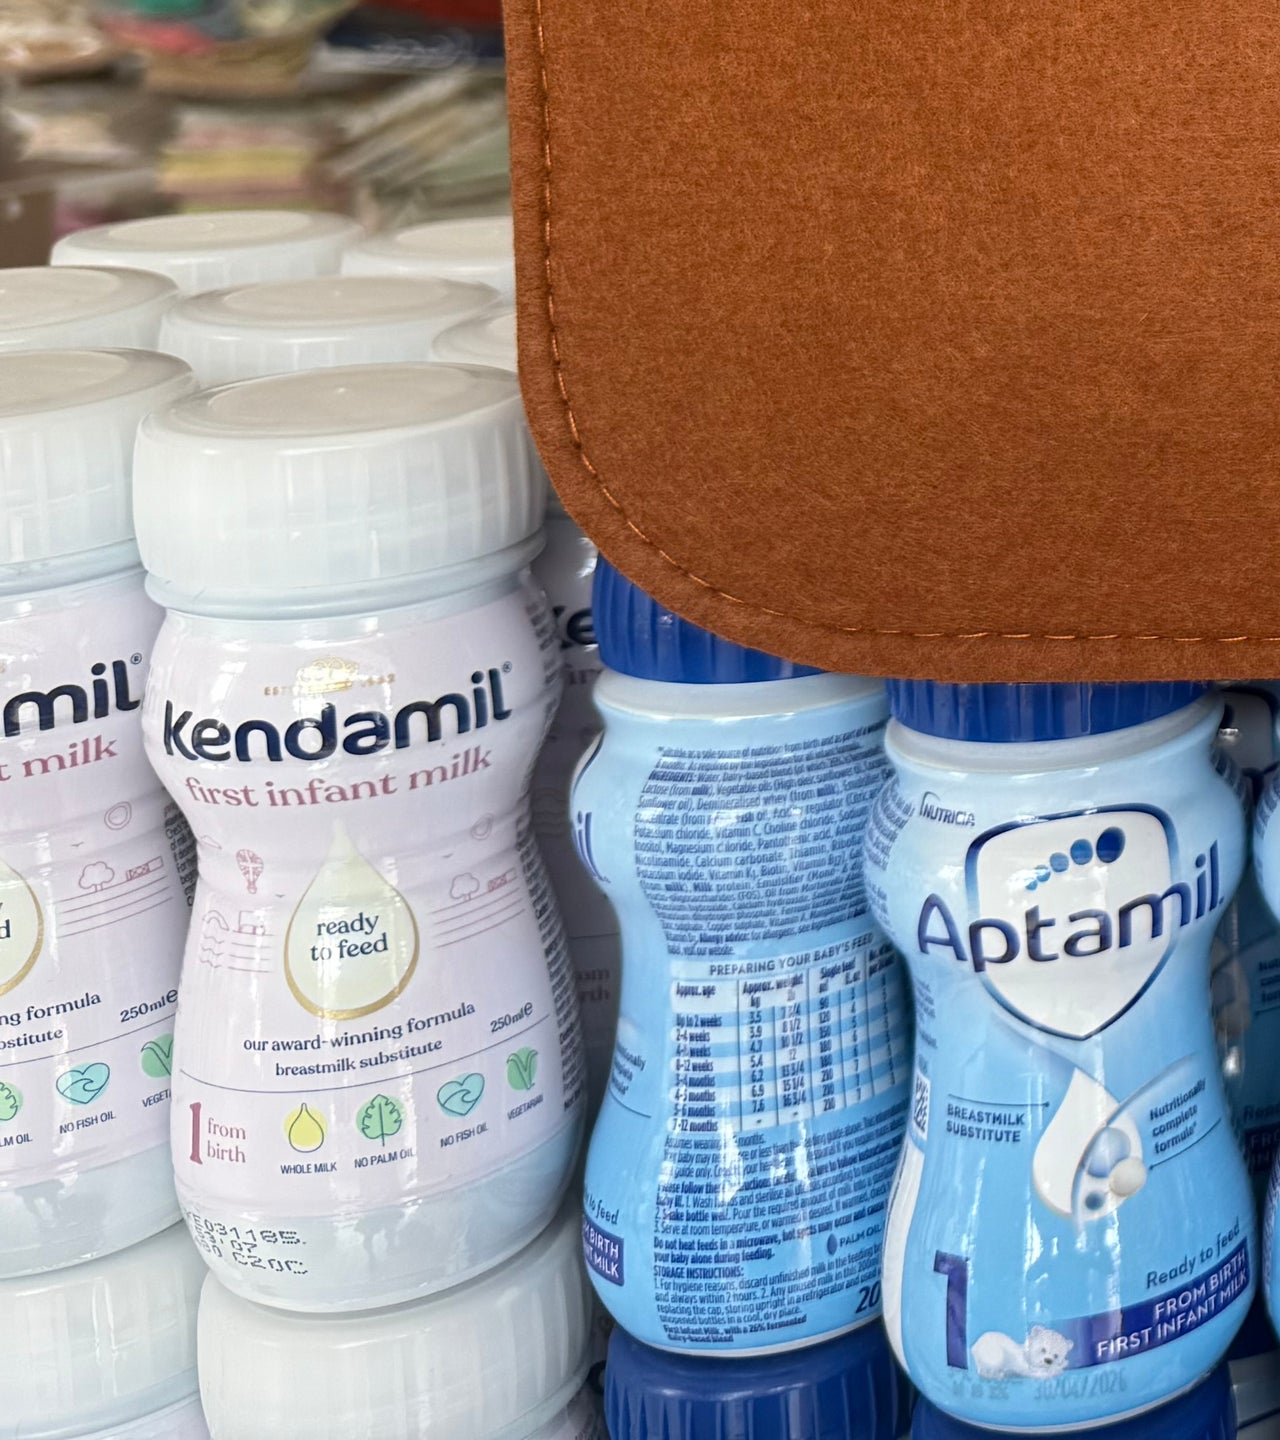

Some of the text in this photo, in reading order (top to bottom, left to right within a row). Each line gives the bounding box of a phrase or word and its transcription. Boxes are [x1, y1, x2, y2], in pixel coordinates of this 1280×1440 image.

[22, 734, 118, 778] milk
[185, 745, 493, 808] first infant milk
[922, 801, 976, 828] NUTRICIA
[917, 840, 1220, 973] Aptamil
[316, 912, 380, 938] ready
[310, 932, 389, 962] to feed
[709, 958, 776, 977] PREPARING
[778, 953, 811, 969] YOUR
[813, 940, 851, 961] BABY'S
[26, 991, 102, 1023] formula
[243, 1001, 476, 1054] our award-winning formula
[274, 1038, 444, 1078] breastmilk substitute
[946, 1103, 1025, 1127] BREASTMILK
[1148, 1078, 1207, 1122] Nutritionally
[59, 1110, 117, 1135] NO FISH OIL
[189, 1101, 247, 1165] 1 from
[440, 1123, 489, 1149] NO FISH OIL
[946, 1121, 1022, 1144] SUBSTITUTE
[1151, 1103, 1199, 1139] complete
[15, 1133, 34, 1145] OIL
[206, 1142, 247, 1164] birth
[280, 1161, 338, 1176] WHOLE MILK
[354, 1147, 416, 1169] NO PALM OIL
[840, 1231, 865, 1248] PALM
[1146, 1215, 1242, 1290] Ready to feed
[653, 1264, 745, 1279] STORAGE INSTRUCTIONS:
[1155, 1248, 1247, 1322] FROM BIRTH
[933, 1249, 968, 1370] 1
[1096, 1268, 1249, 1360] FIRST INFANT MILK
